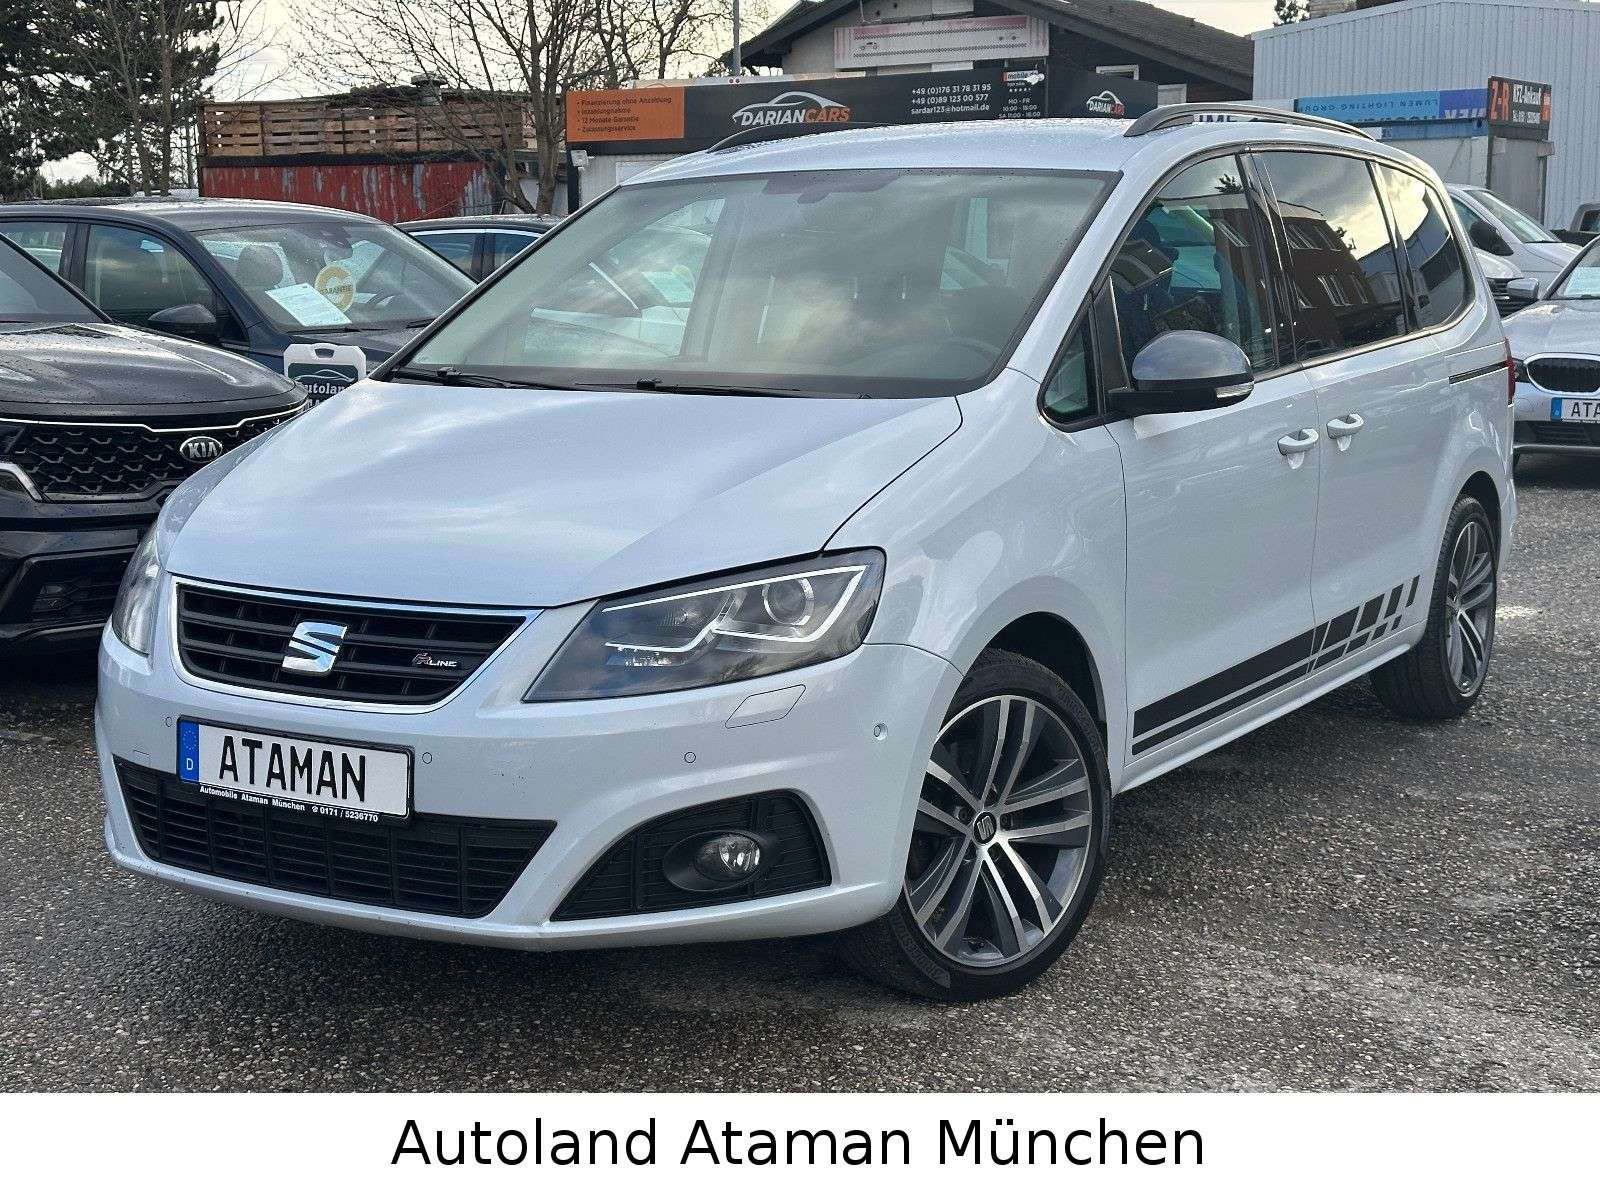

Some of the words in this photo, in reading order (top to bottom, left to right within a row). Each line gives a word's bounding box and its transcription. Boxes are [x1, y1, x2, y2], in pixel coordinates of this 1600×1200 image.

[952, 85, 960, 93] 31
[972, 84, 980, 92] 31
[981, 83, 991, 91] 95
[741, 107, 851, 126] DARIANCARS
[188, 441, 218, 458] KIA
[186, 757, 194, 771] D
[219, 735, 366, 802] ATAMAN
[200, 785, 238, 800] Automobile
[241, 791, 269, 804] Ataman
[272, 798, 306, 811] München
[319, 806, 338, 818] 0171
[345, 810, 379, 823] 5236770
